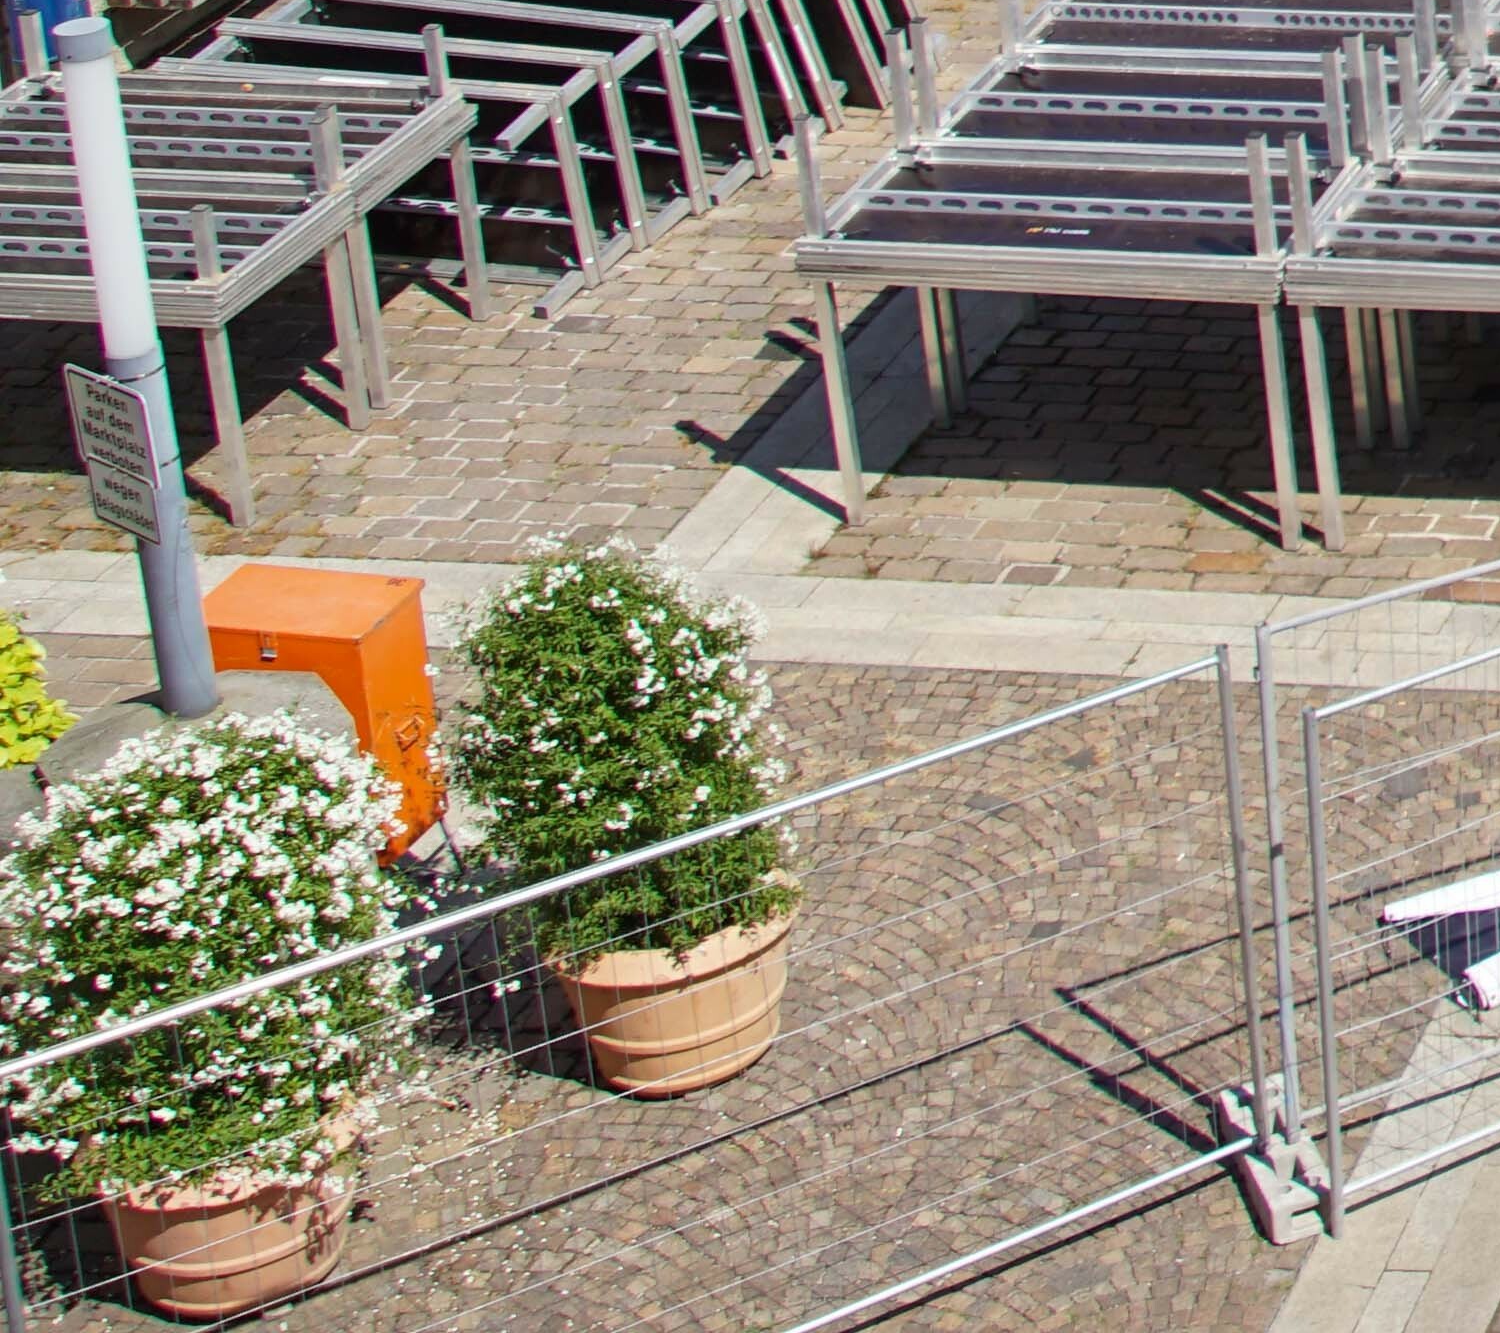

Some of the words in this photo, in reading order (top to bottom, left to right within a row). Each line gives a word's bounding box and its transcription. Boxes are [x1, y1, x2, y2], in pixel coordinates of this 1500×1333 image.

[85, 383, 129, 414] Parken
[86, 405, 105, 423] auf
[108, 413, 135, 435] dem
[82, 418, 147, 459] Marktplatz
[104, 476, 143, 503] wegen
